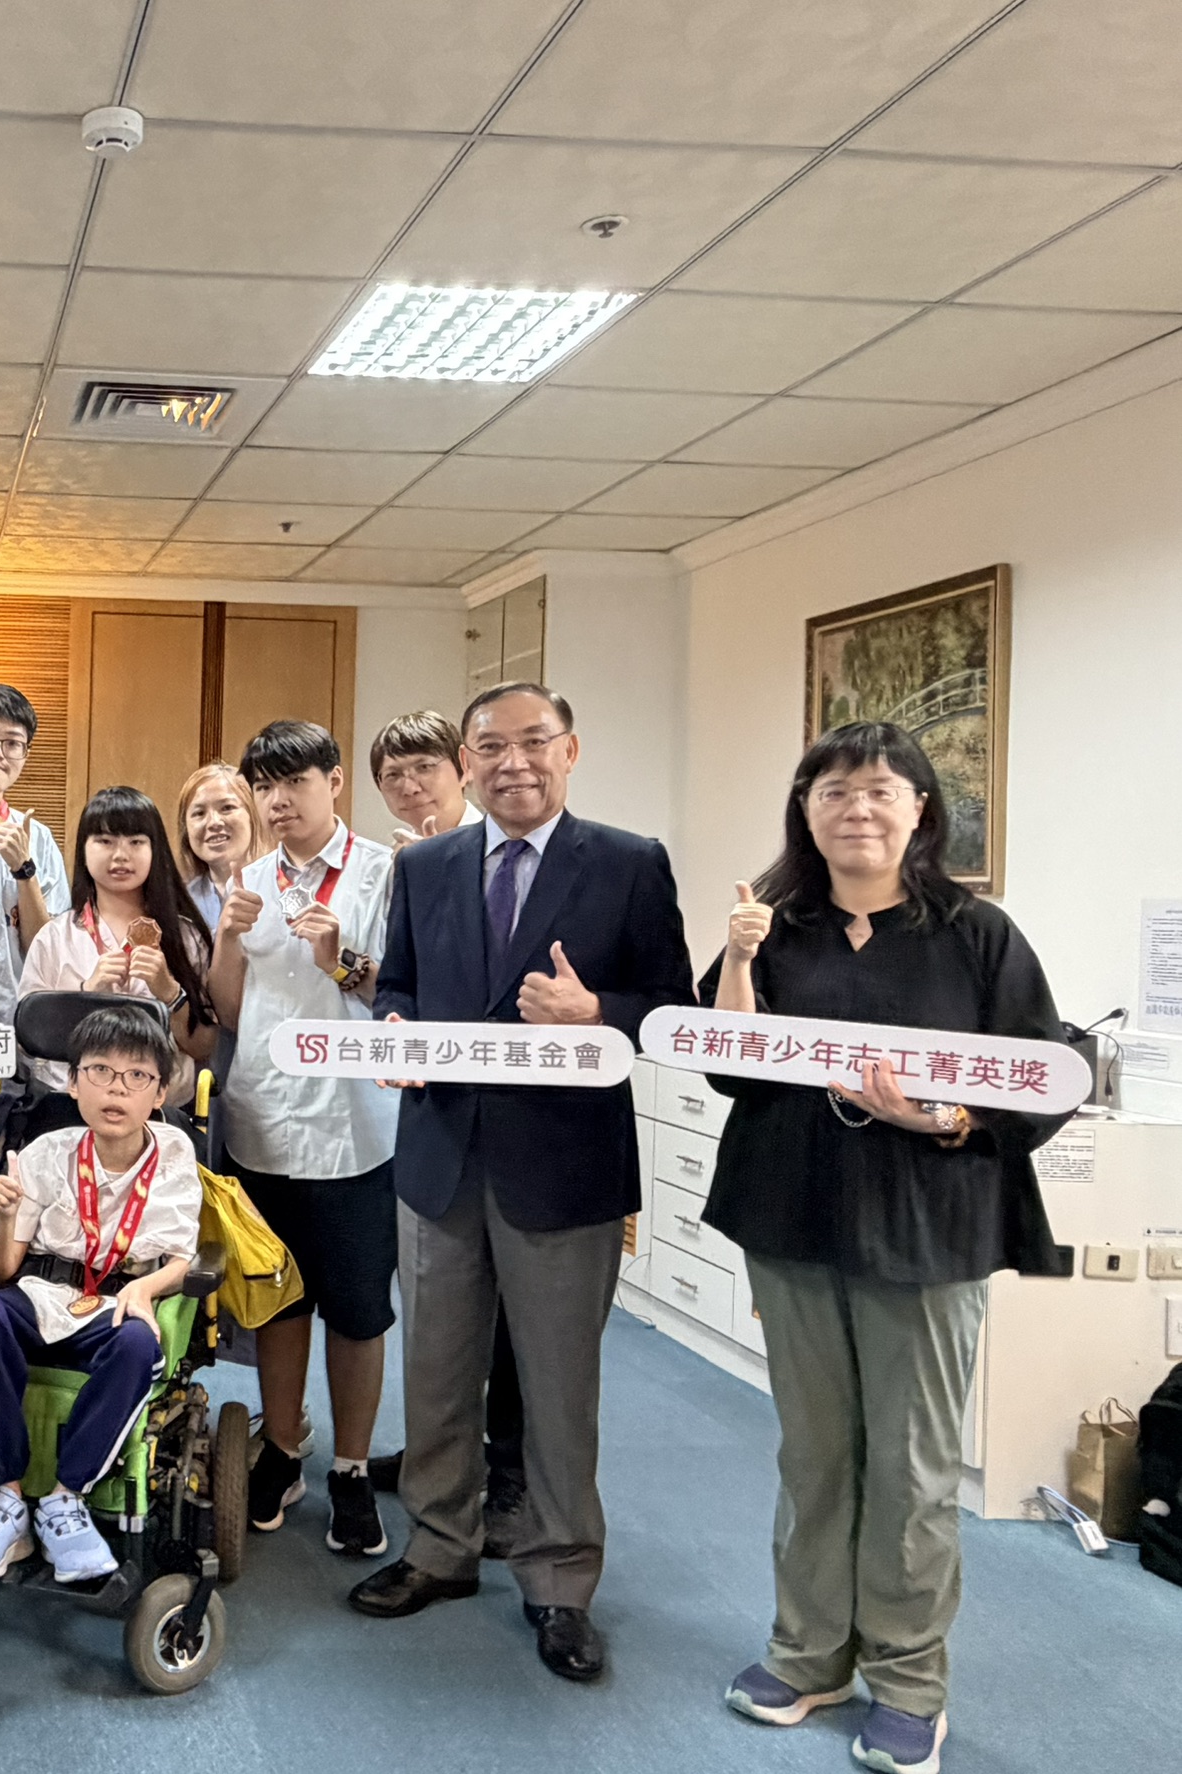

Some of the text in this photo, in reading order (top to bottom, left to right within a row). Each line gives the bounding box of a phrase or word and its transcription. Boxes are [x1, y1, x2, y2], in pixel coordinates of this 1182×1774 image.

[337, 1036, 603, 1070] 台新青少年基金會
[670, 1024, 1050, 1095] 台新青少年志工菁英獎
